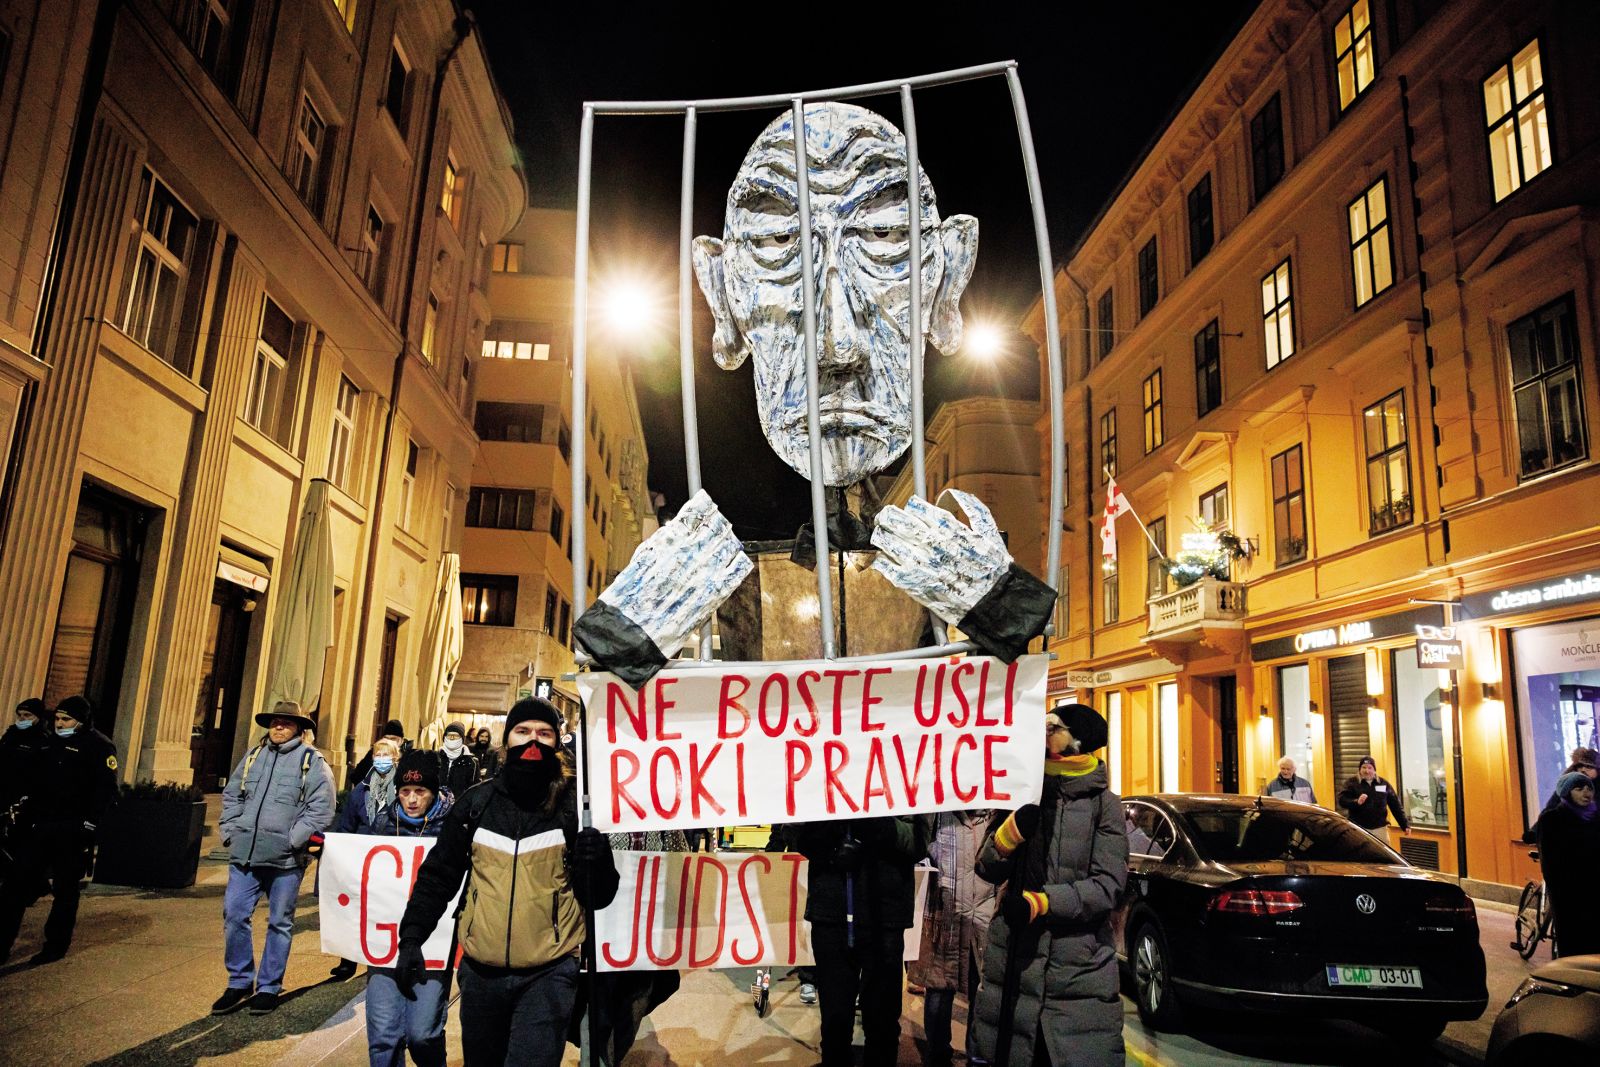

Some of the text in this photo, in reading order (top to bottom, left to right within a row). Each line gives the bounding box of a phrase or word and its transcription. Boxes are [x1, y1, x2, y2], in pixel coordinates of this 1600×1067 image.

[1070, 674, 1094, 684] ecco
[607, 677, 682, 744] NE
[717, 667, 892, 740] BOSTE
[609, 733, 1012, 823] ROKI PRAVICE
[1343, 967, 1415, 984] CMD 03-01
